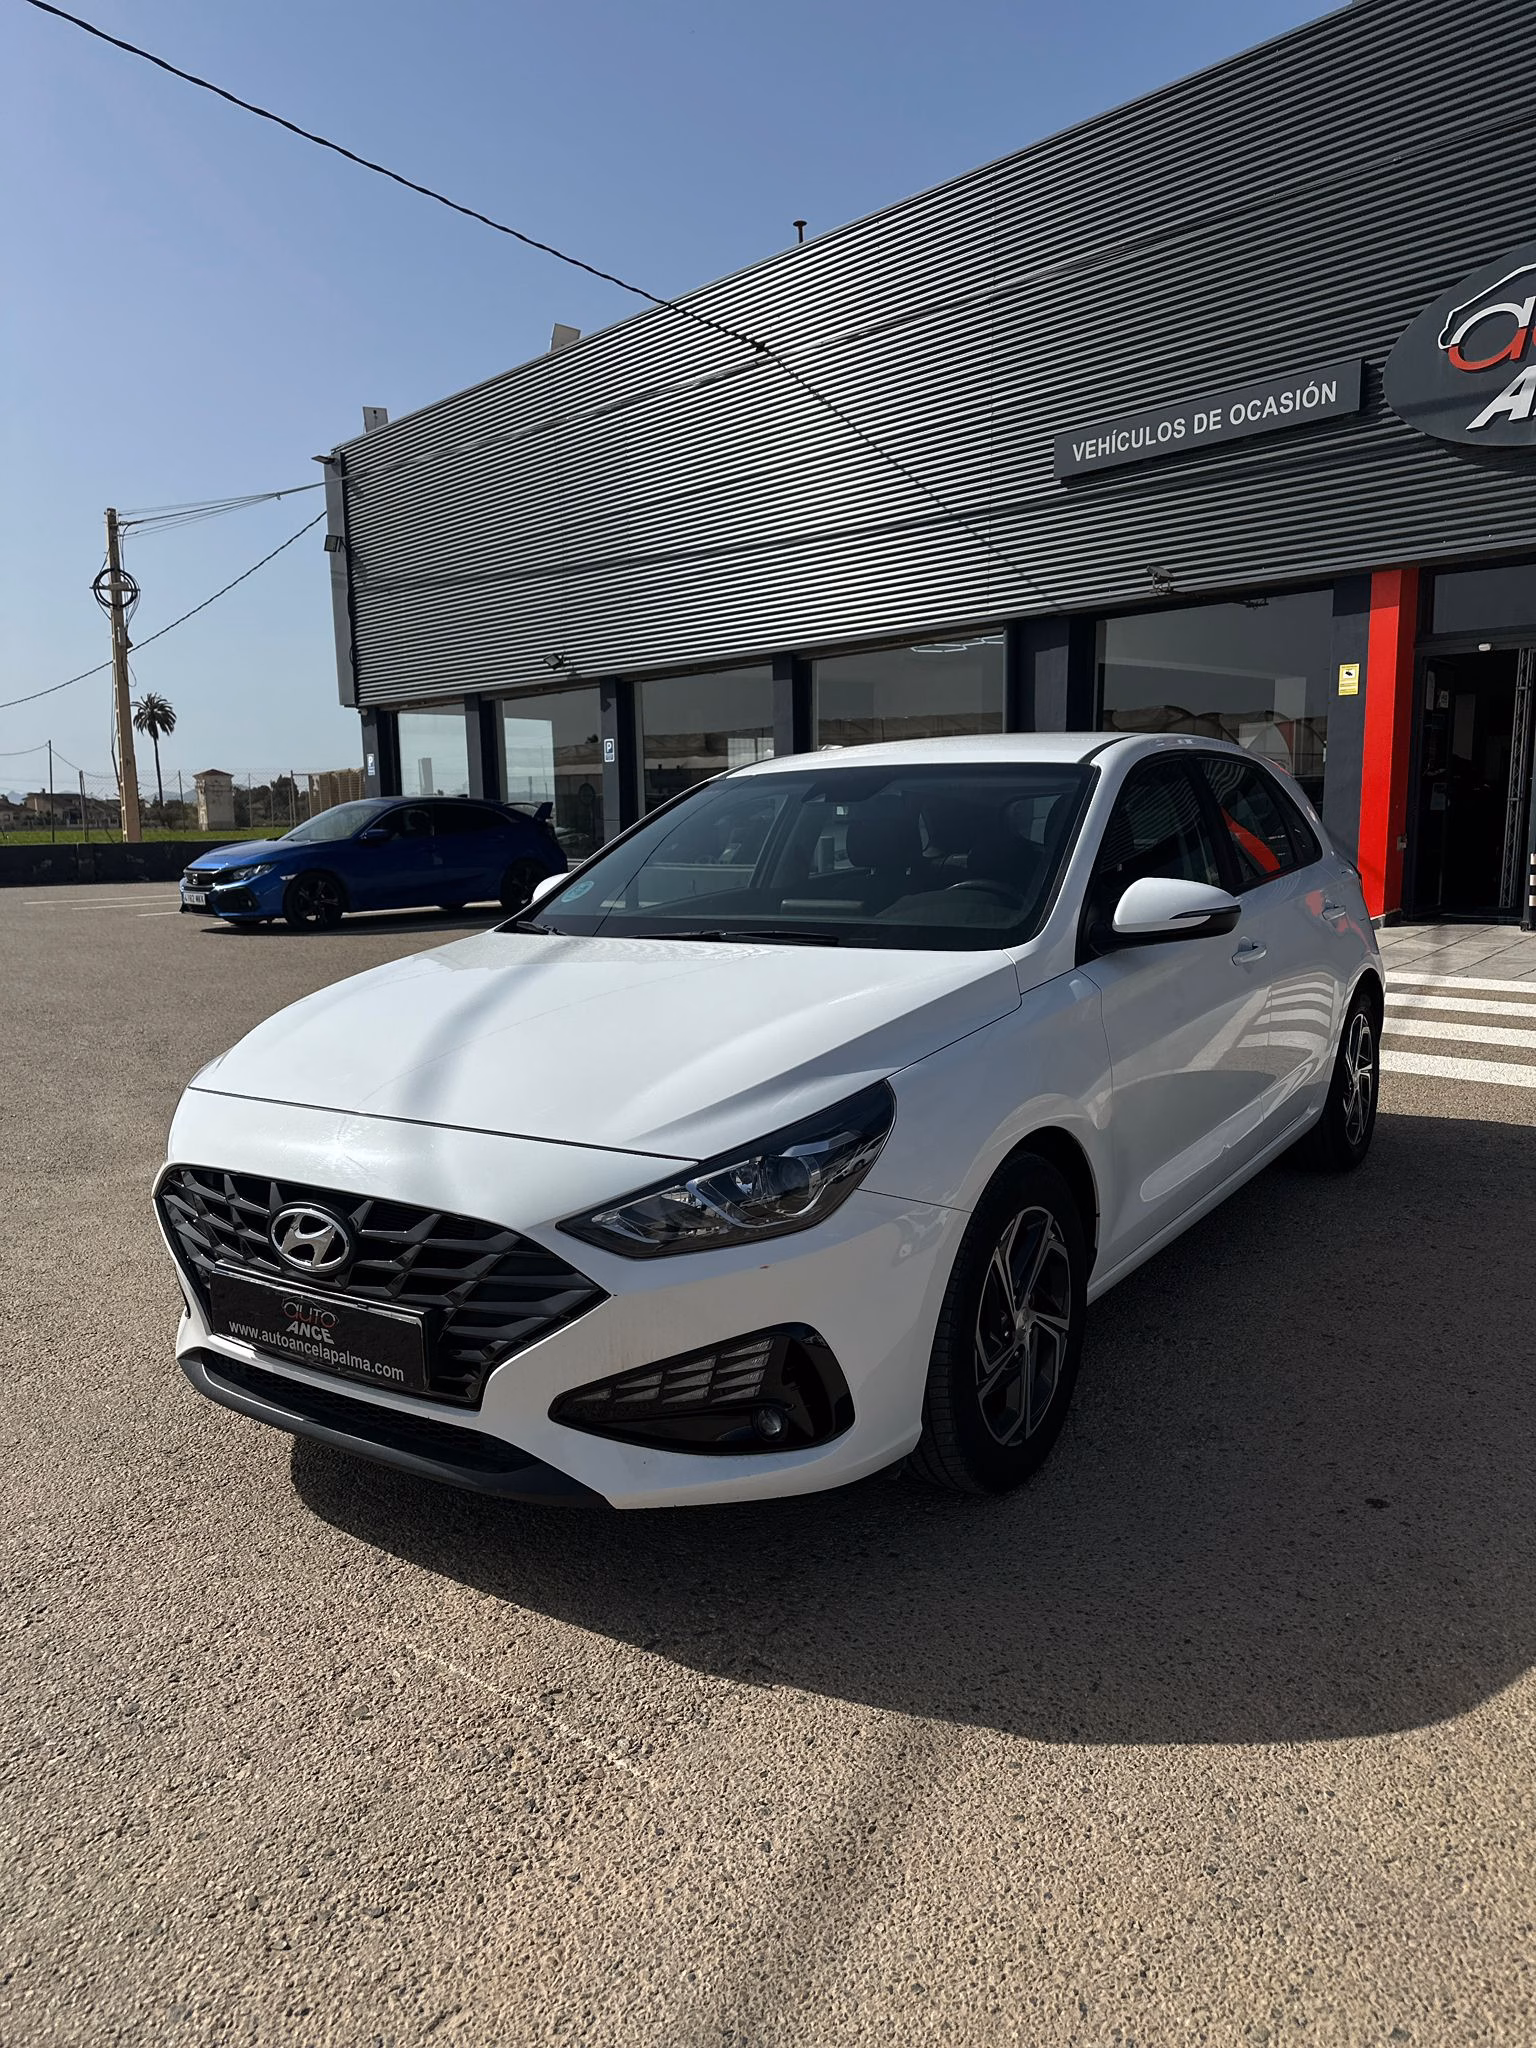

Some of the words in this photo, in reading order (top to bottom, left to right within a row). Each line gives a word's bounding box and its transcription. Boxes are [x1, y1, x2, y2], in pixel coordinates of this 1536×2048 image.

[1072, 418, 1186, 462] VEHÍCULOS
[1193, 408, 1222, 434] DE
[1229, 380, 1337, 426] OCASIÓN
[228, 1320, 404, 1382] www.autoancelapalma.com
[286, 1320, 335, 1345] ANCE
